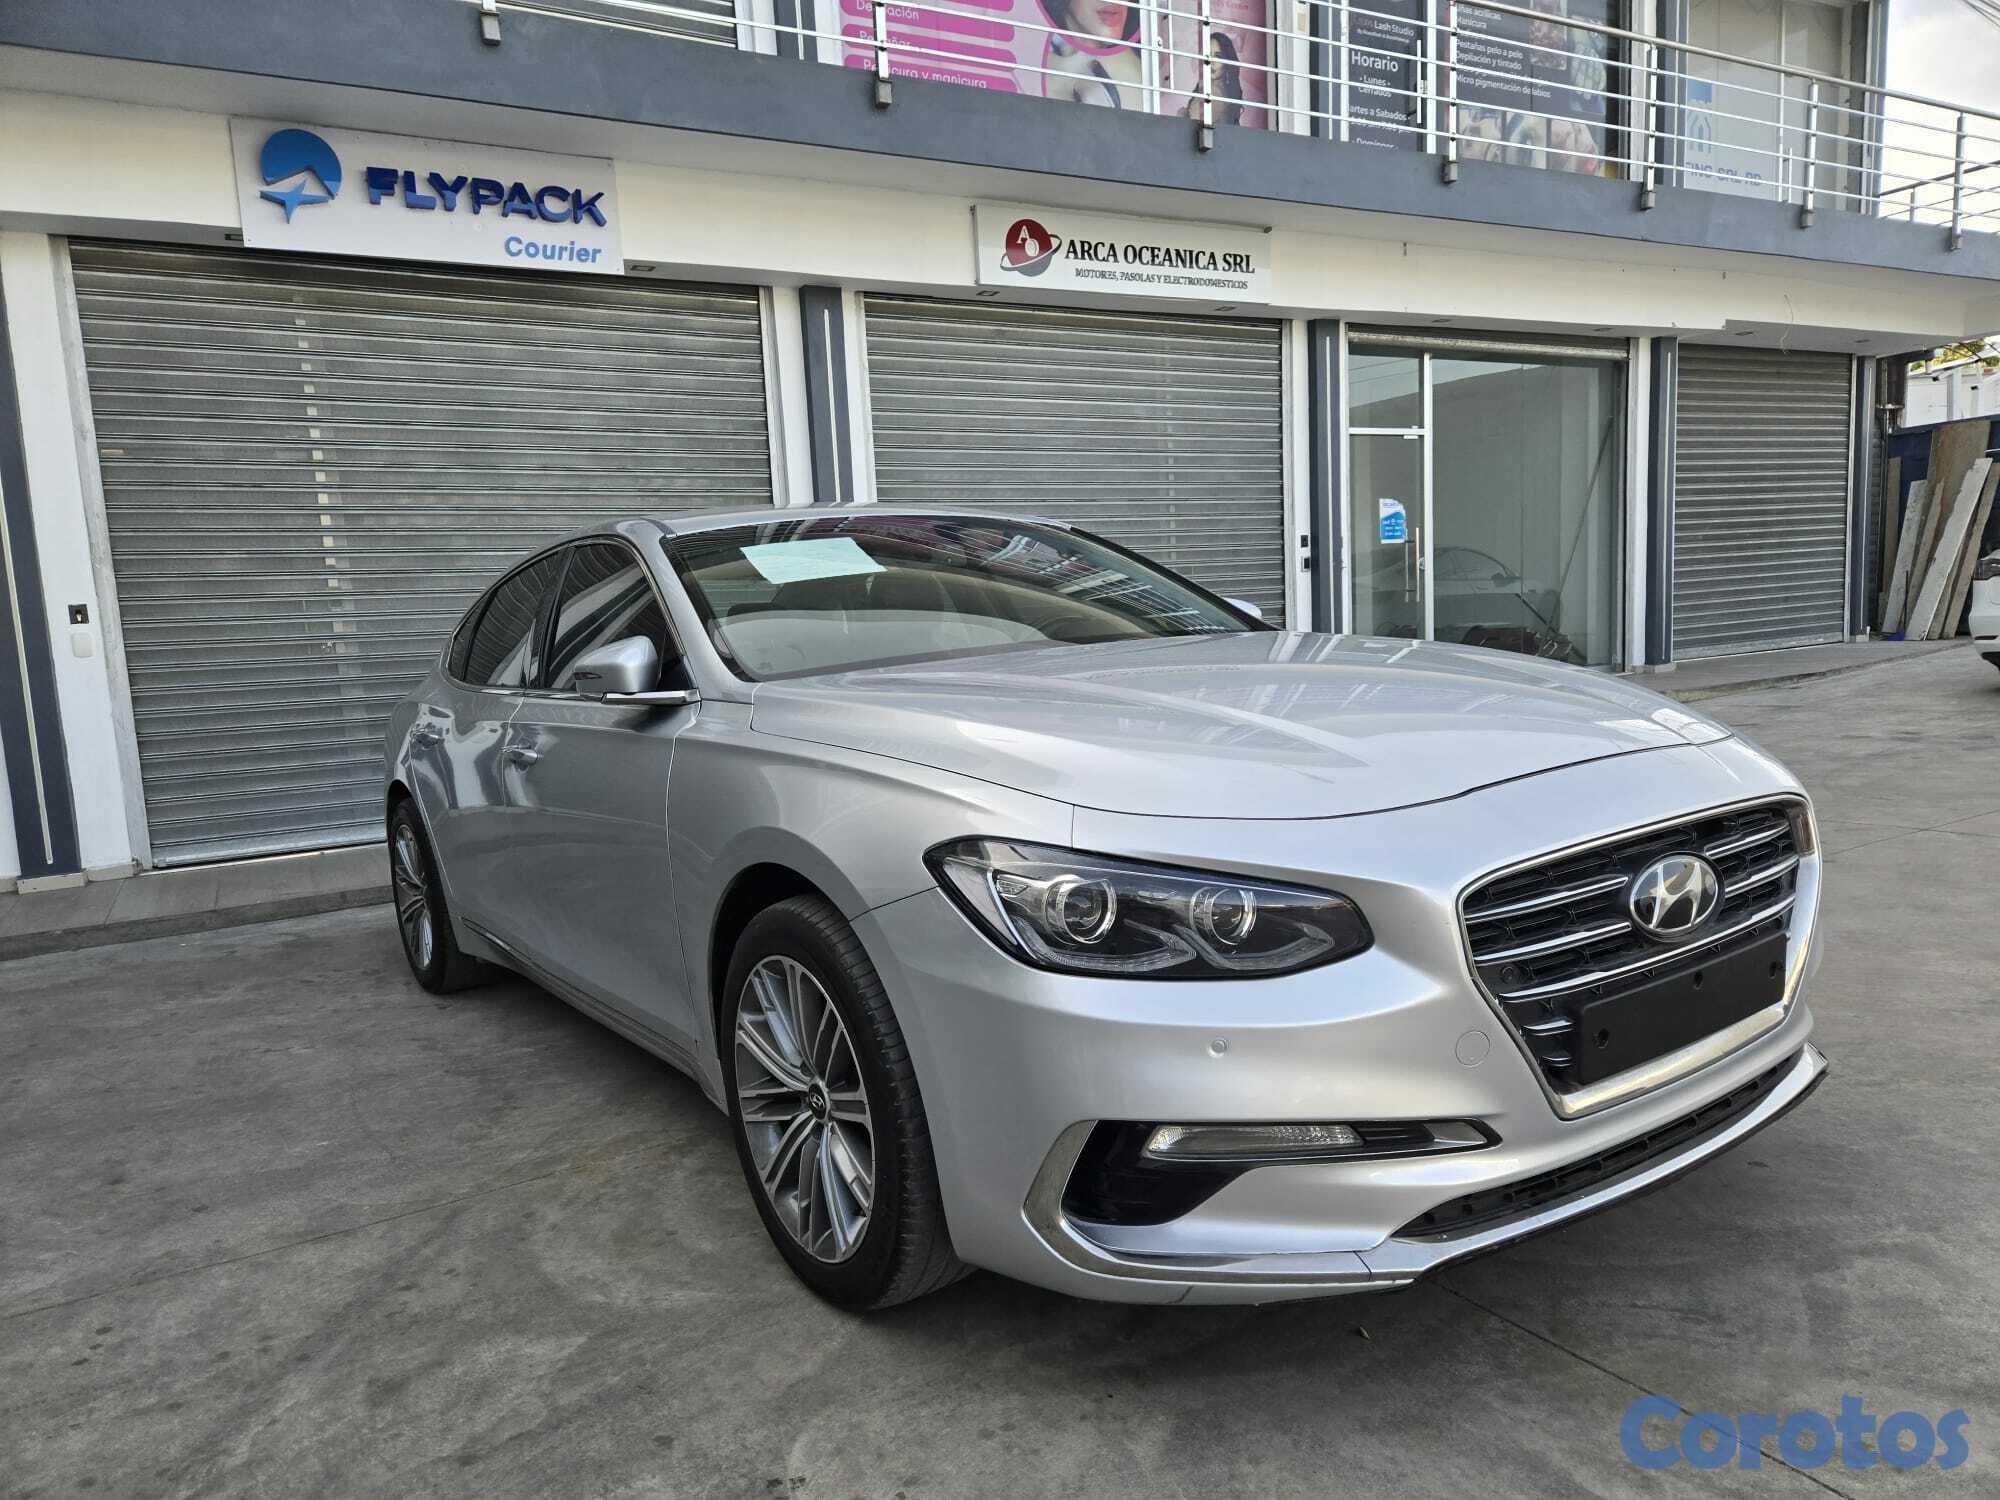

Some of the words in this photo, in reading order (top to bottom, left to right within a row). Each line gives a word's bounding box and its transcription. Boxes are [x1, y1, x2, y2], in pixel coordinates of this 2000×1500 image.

[857, 0, 920, 20] Deación
[864, 59, 918, 79] Peicura
[1352, 50, 1399, 72] Horario
[366, 166, 608, 227] FLYPACK
[504, 236, 602, 264] Courier
[1064, 240, 1120, 264] ARCA
[1123, 244, 1219, 272] OCEANICA
[1222, 252, 1256, 274] SRL
[1075, 268, 1119, 281] MOTORES,
